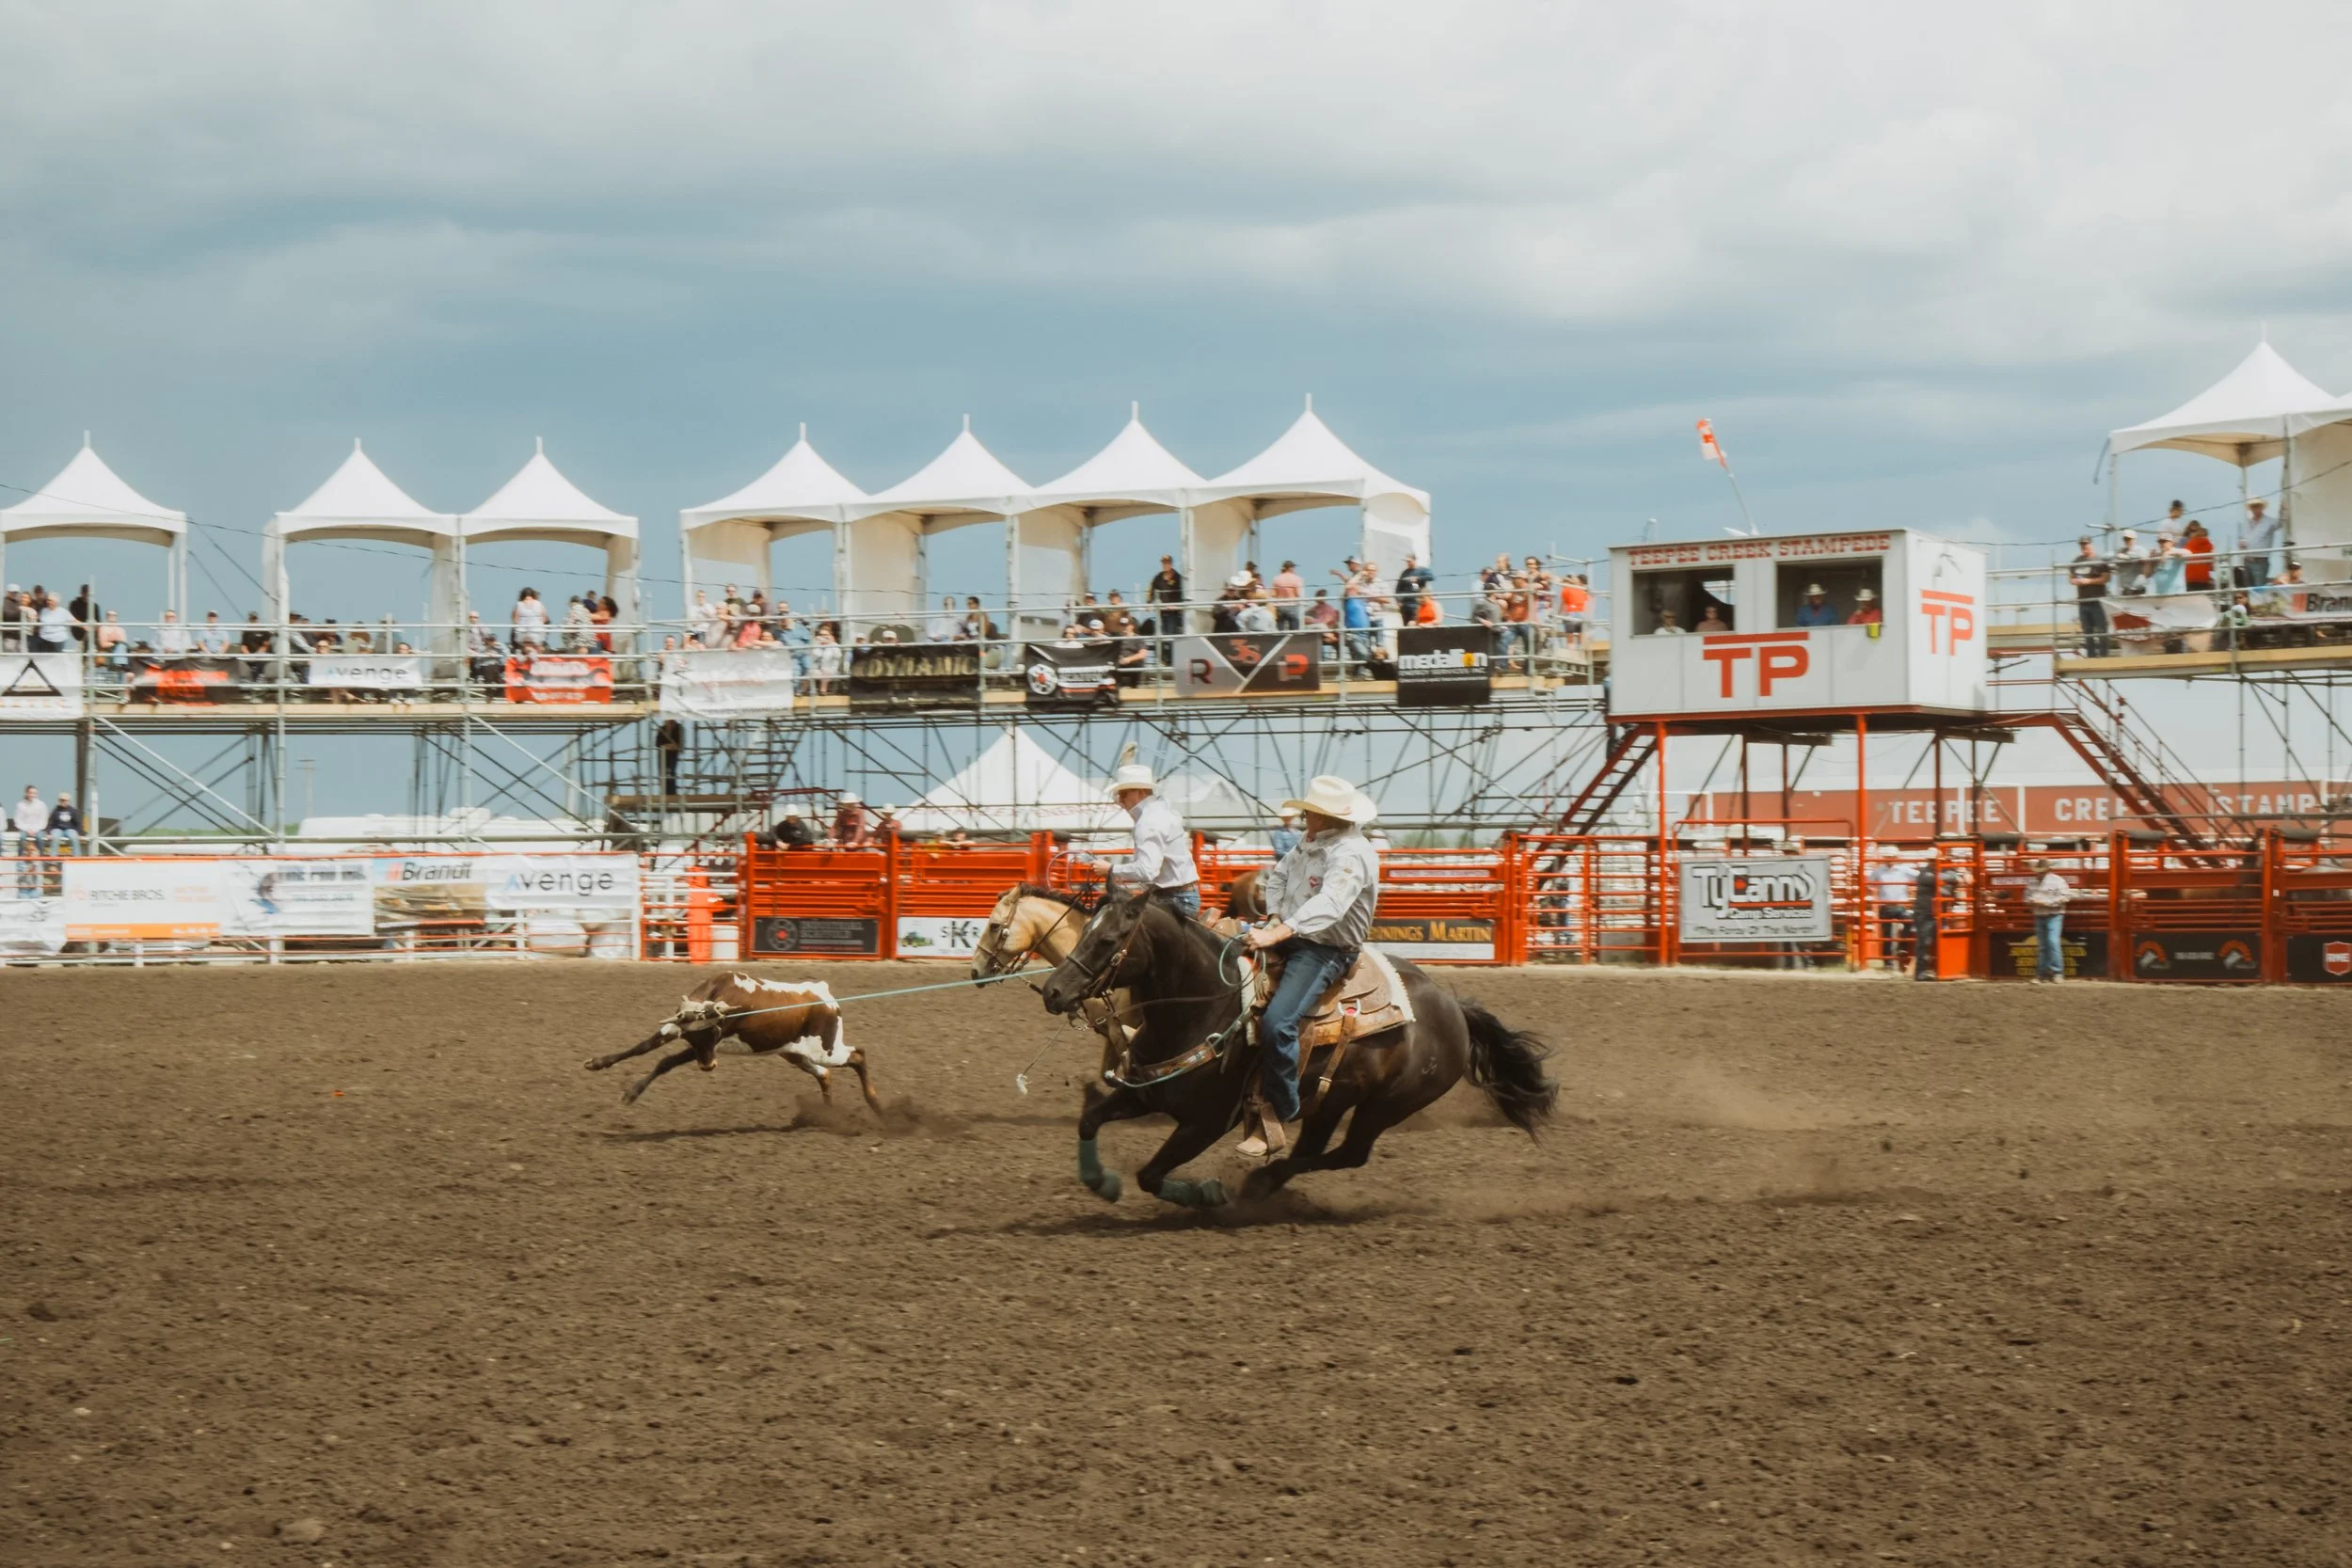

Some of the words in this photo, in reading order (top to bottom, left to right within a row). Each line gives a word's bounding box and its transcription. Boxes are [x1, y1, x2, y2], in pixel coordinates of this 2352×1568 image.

[1628, 546, 1701, 565] TEEPEE
[1707, 541, 1772, 561] CREEK
[1779, 534, 1890, 556] STAMPEDE
[1921, 602, 1973, 656] TP
[1703, 644, 1809, 698] TP
[2055, 799, 2151, 821] CREE
[504, 872, 614, 896] Avenge
